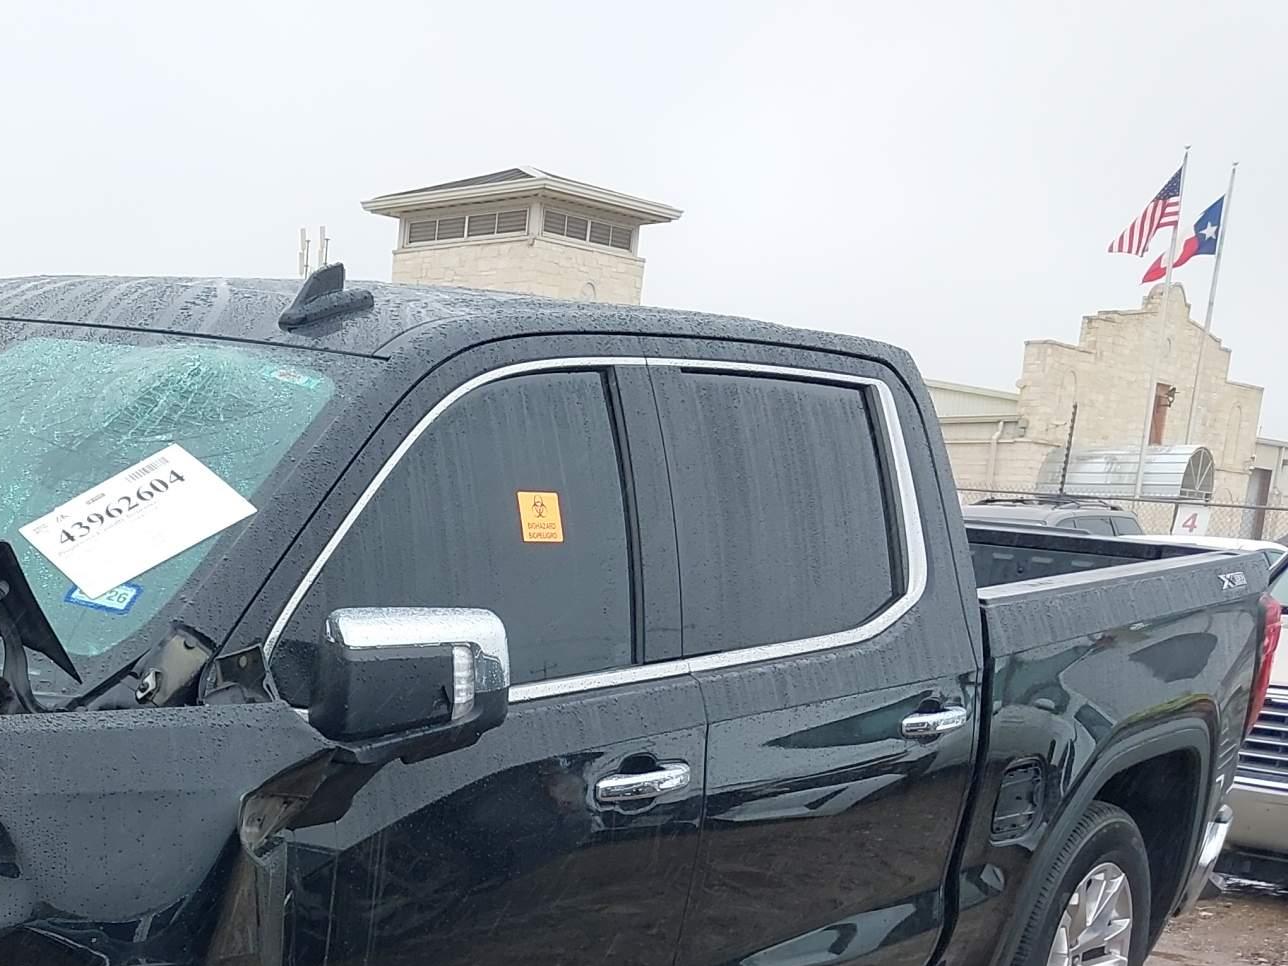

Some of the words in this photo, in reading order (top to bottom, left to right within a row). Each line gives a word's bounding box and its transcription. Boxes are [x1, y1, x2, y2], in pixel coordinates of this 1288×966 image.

[59, 469, 186, 545] 43962604
[1182, 512, 1198, 533] 4
[106, 590, 128, 604] 26
